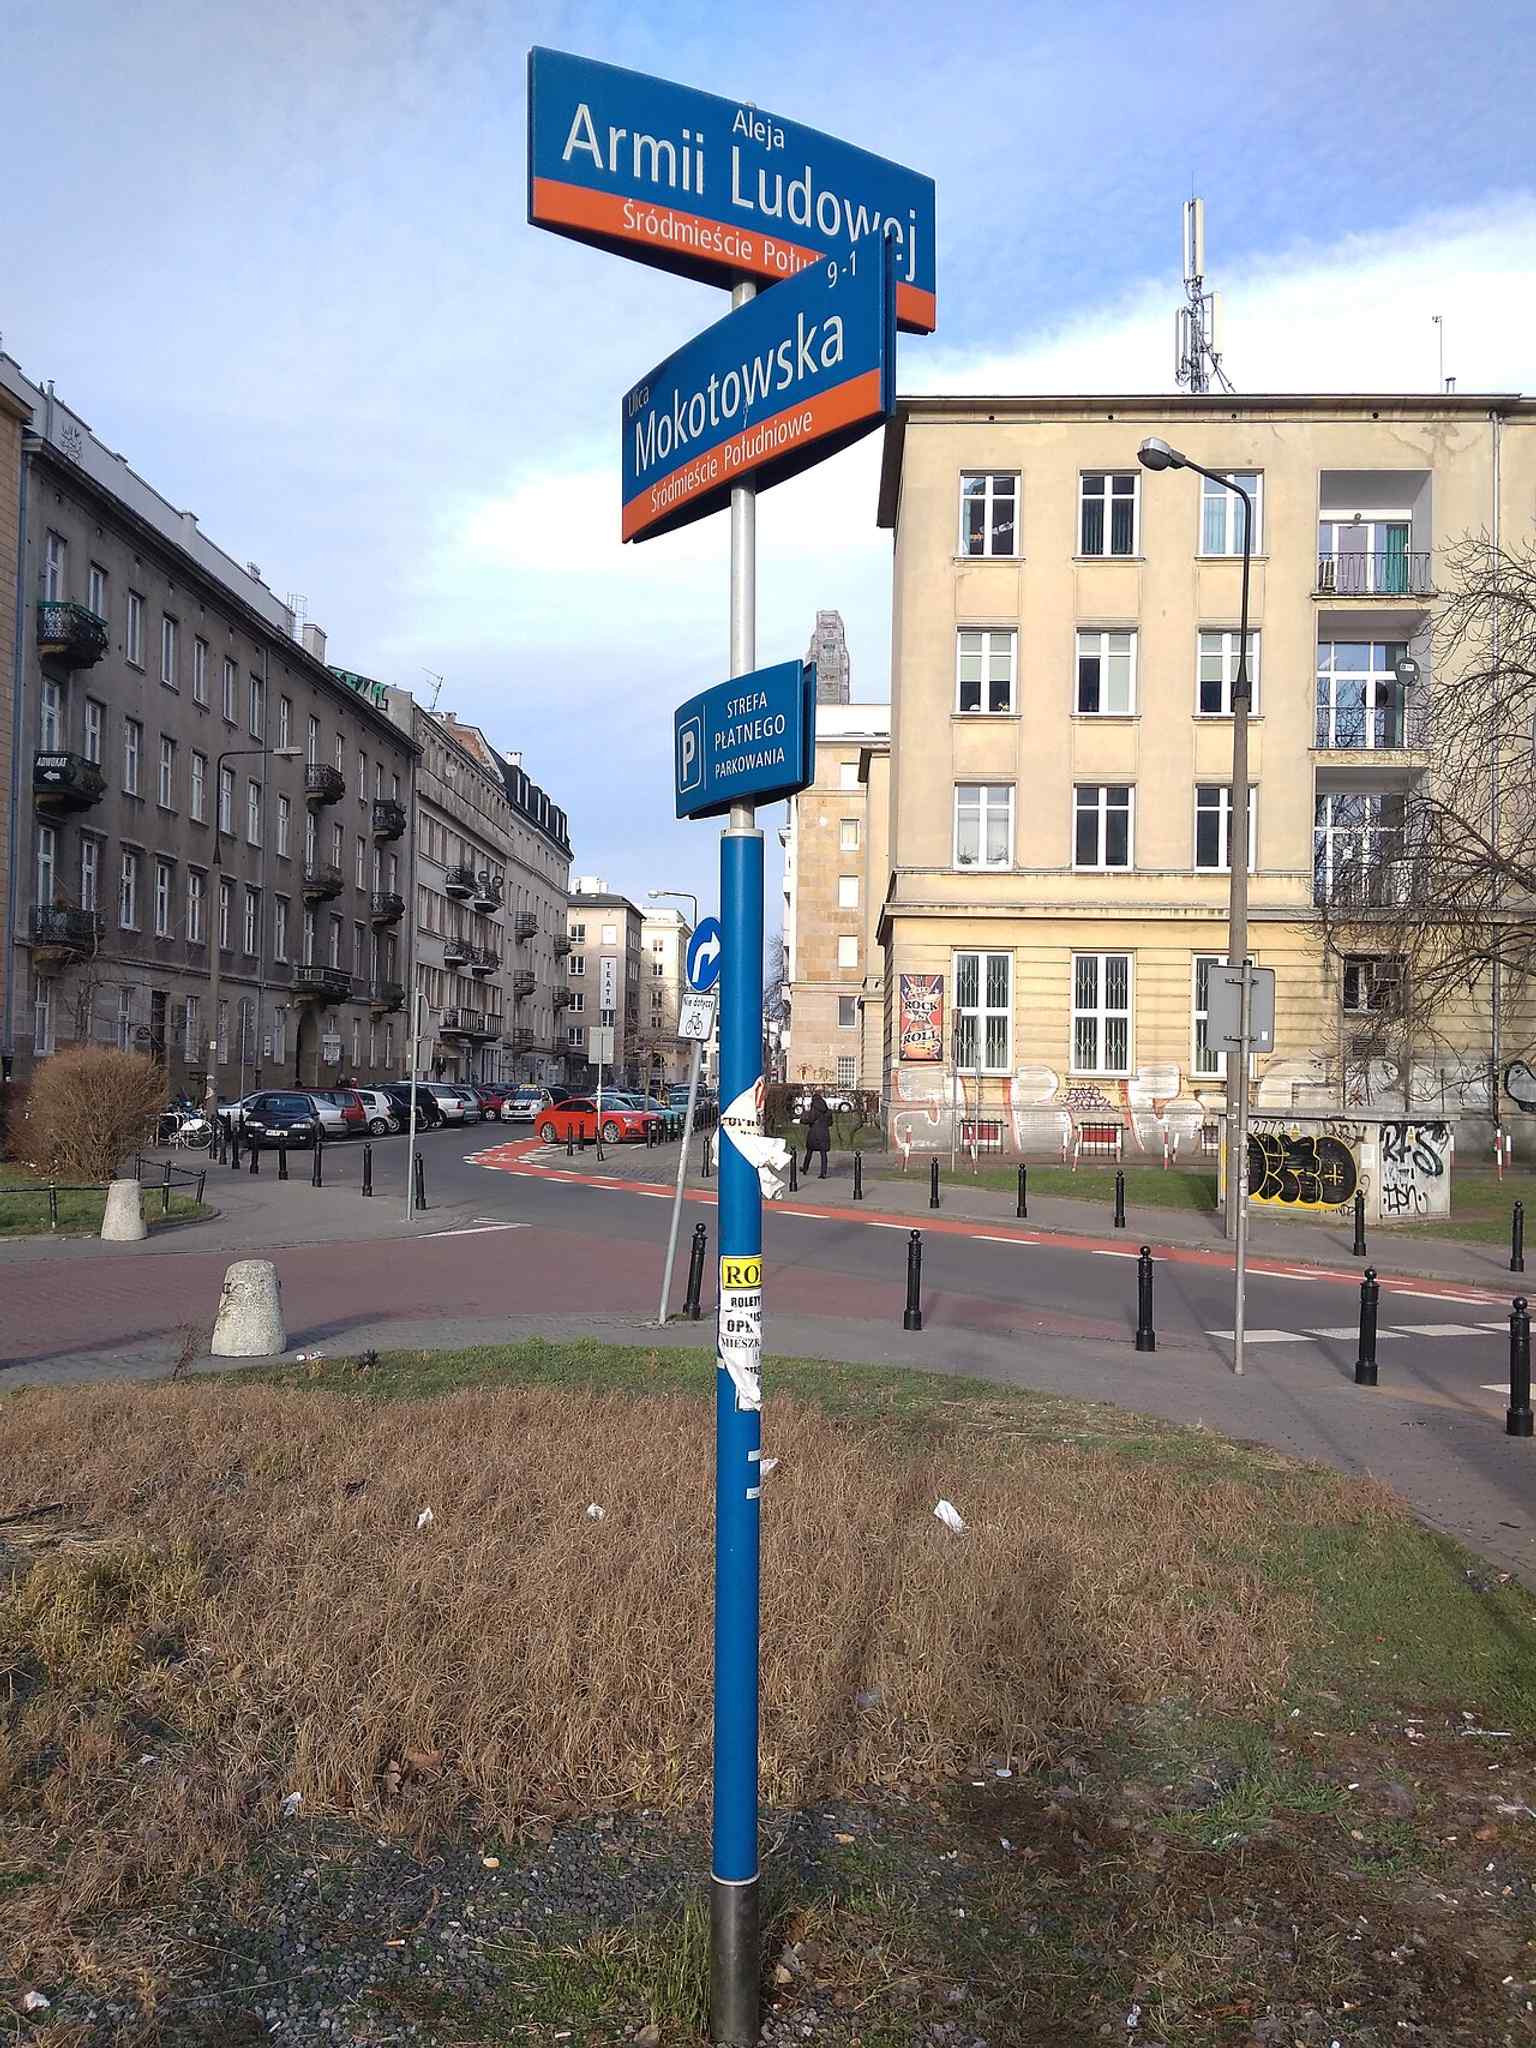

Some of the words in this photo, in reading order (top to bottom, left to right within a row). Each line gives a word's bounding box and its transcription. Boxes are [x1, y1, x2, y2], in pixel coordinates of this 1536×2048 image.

[731, 109, 785, 149] Aleja
[562, 103, 705, 195] Armii
[622, 198, 753, 261] Śródmieście
[827, 250, 857, 289] 9-1
[627, 384, 650, 418] Ulica
[634, 312, 845, 478] Mokotowska
[650, 456, 718, 513] Śródmieście
[723, 411, 813, 472] Południowe
[727, 690, 768, 719] STREFA
[714, 714, 786, 753] PŁATNEGO
[714, 747, 785, 779] PARKOWANIA
[904, 999, 938, 1011] ROCK
